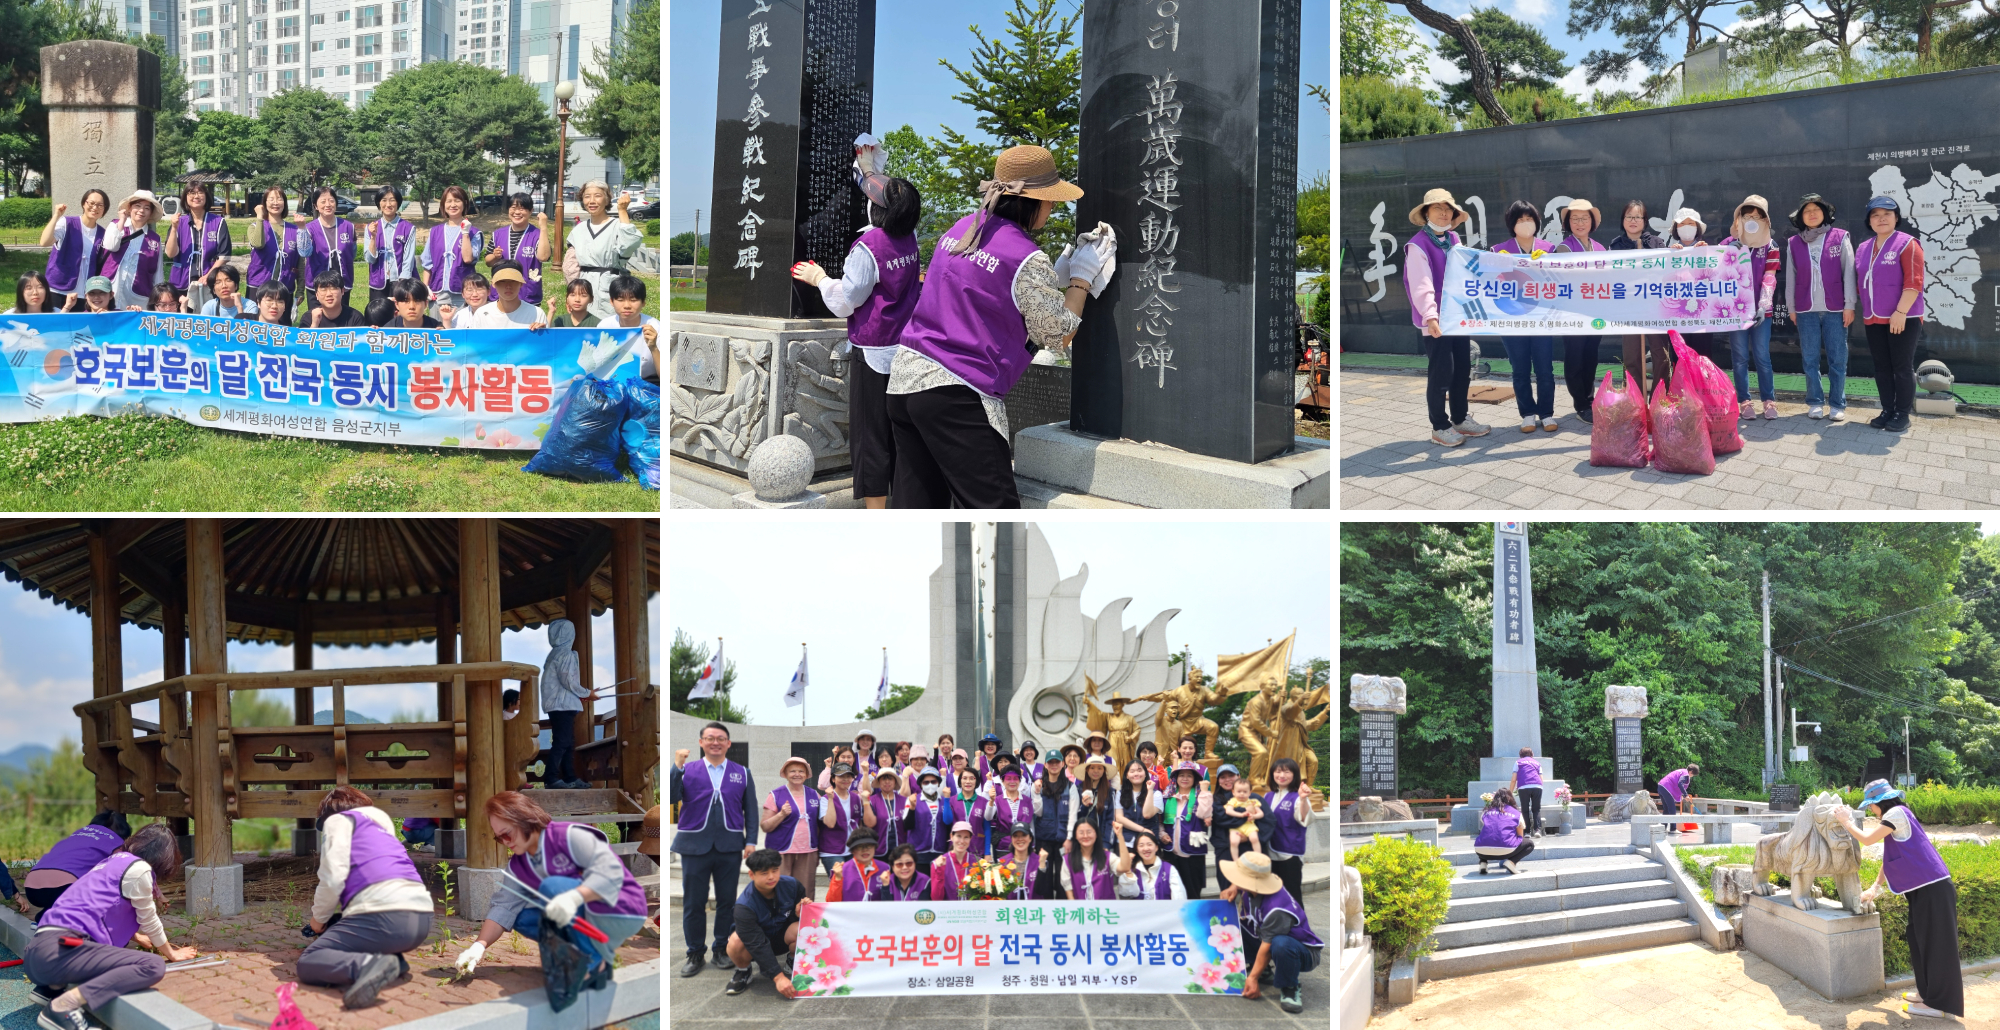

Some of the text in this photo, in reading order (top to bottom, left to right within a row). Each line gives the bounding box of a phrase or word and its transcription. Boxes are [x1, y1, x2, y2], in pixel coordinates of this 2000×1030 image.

[1867, 145, 1971, 161] 제천시 의병배치 및 관군 진격로
[1128, 67, 1184, 389] 萬歲運動紀念碑
[1612, 259, 1636, 269] 전국
[1641, 257, 1666, 269] 동시
[1671, 256, 1718, 269] 봉사활동
[1464, 279, 1738, 299] 당신의 희생과 헌신을 기억하겠습니다
[1468, 319, 1487, 328] 장소:
[1489, 320, 1536, 328] 제천의병광장
[1547, 319, 1584, 328] 평화소녀상
[1680, 319, 1706, 327] 충청북도
[139, 315, 455, 355] 세계평화여성연합 회원과 함께하는
[74, 346, 553, 414] 호국보훈의 달 전국 동시 봉사활동
[223, 408, 402, 437] 세계평화여성연합 음성군지부
[995, 907, 1046, 925] 회원과
[1052, 907, 1120, 925] 함께하는
[853, 932, 1189, 967] 호국보훈의 달 전국 동시 봉사활동
[907, 976, 931, 988] 장소:
[935, 975, 974, 987] 삼일공원
[1112, 976, 1137, 985] YSP
